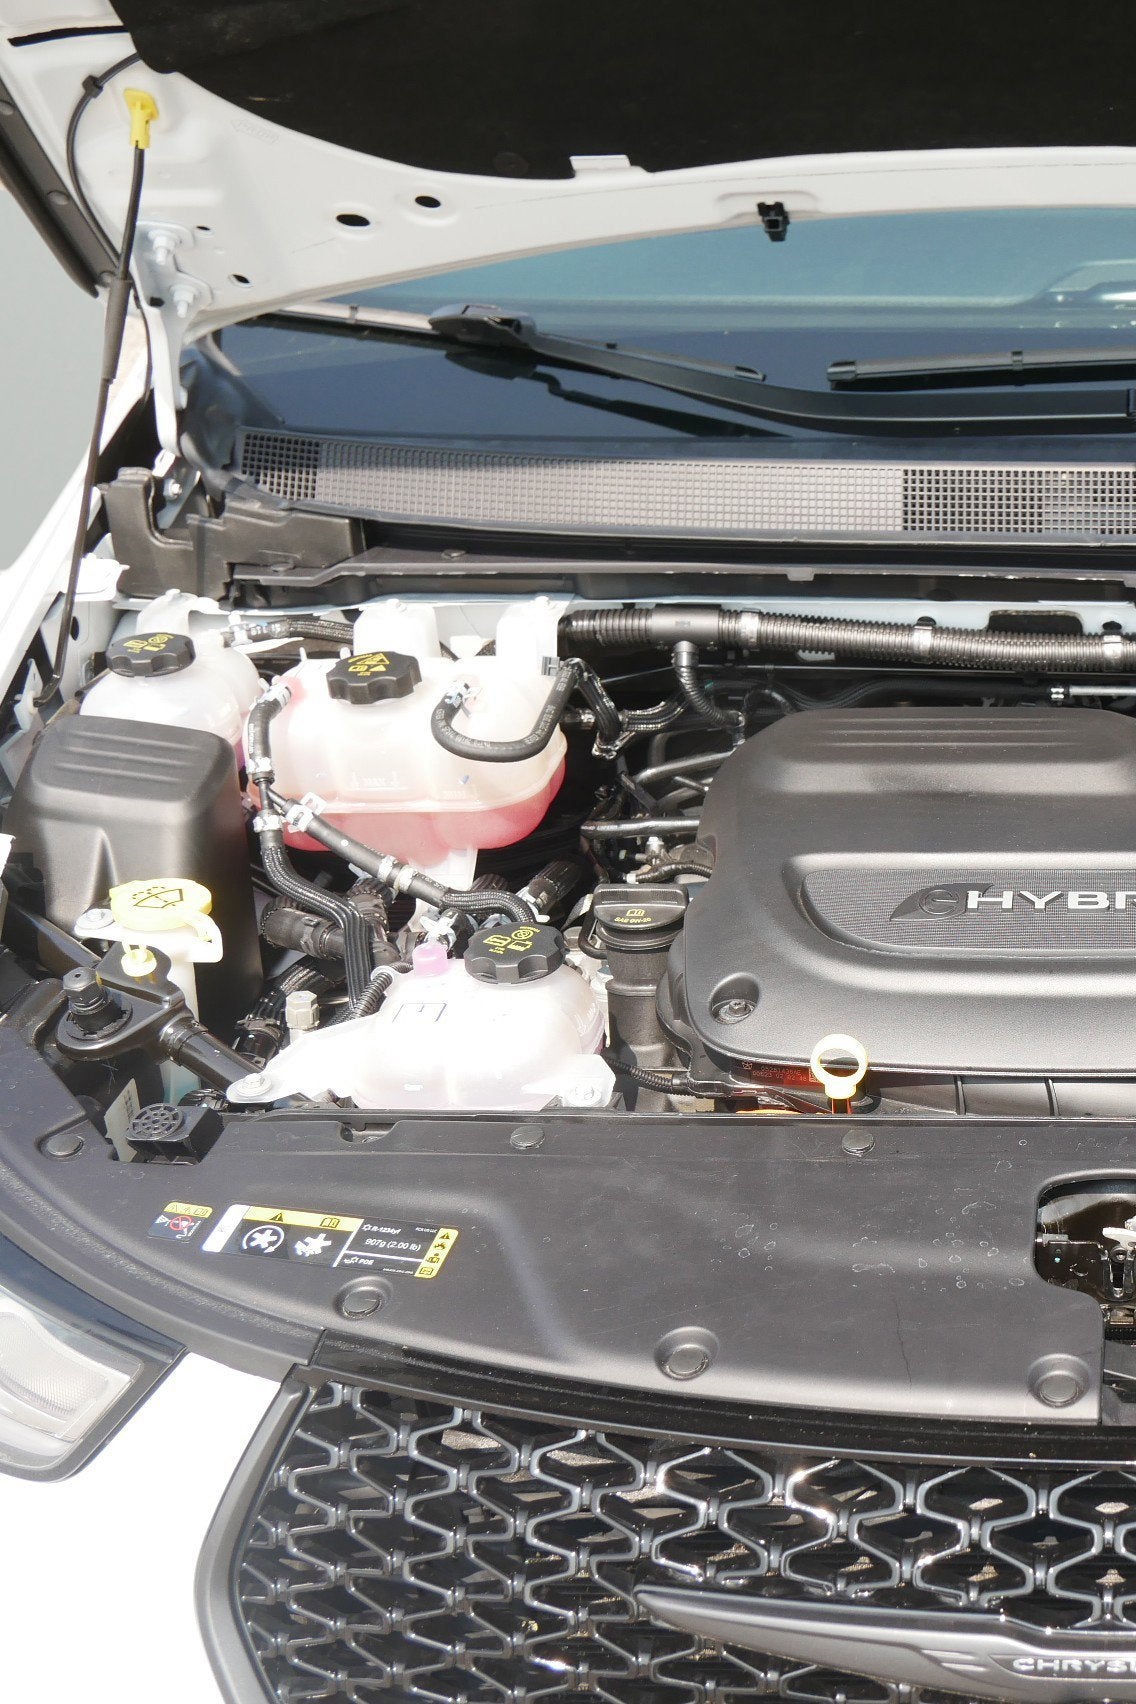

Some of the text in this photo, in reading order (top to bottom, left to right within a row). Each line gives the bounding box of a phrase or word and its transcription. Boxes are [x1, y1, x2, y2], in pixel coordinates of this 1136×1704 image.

[365, 1238, 422, 1252] 907g (2.00 lb)
